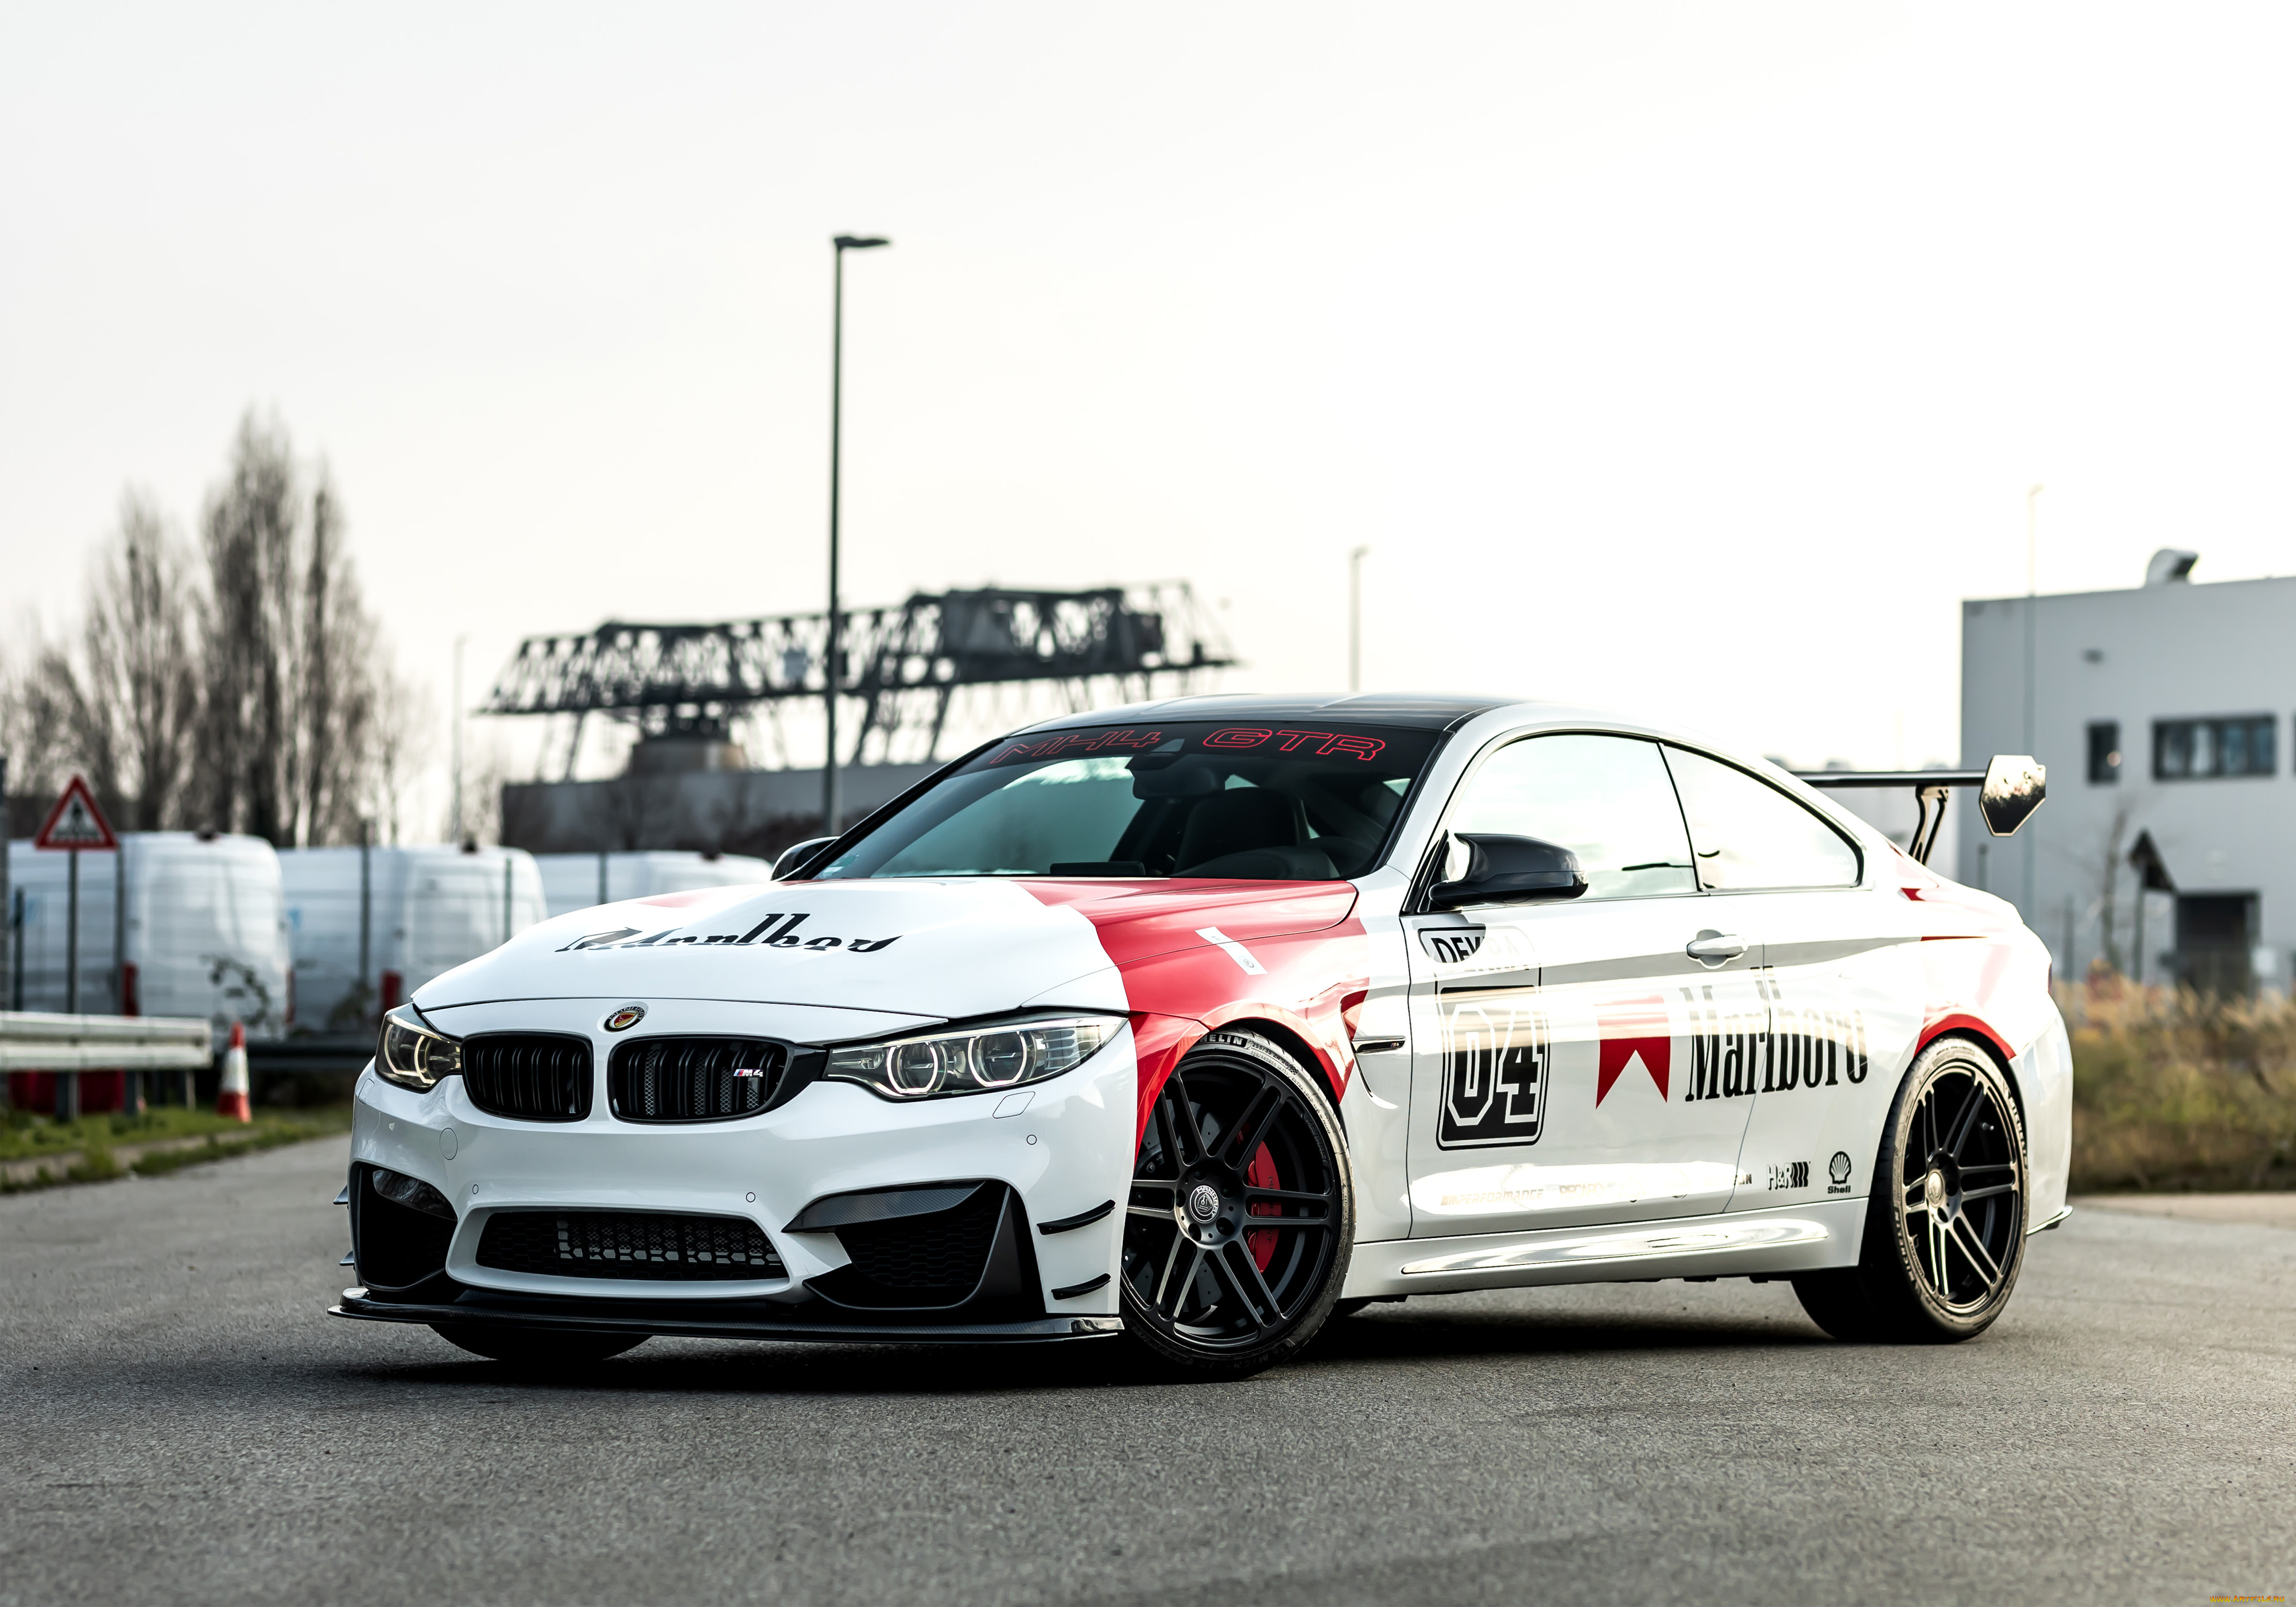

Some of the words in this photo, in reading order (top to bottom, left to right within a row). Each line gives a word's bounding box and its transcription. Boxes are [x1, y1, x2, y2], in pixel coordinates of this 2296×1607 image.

[990, 730, 1162, 764] MH4
[1203, 728, 1386, 761] GTR
[1447, 1004, 1543, 1127] 04
[1679, 965, 1868, 1103] Marlboro
[1827, 1185, 1851, 1194] Shell
